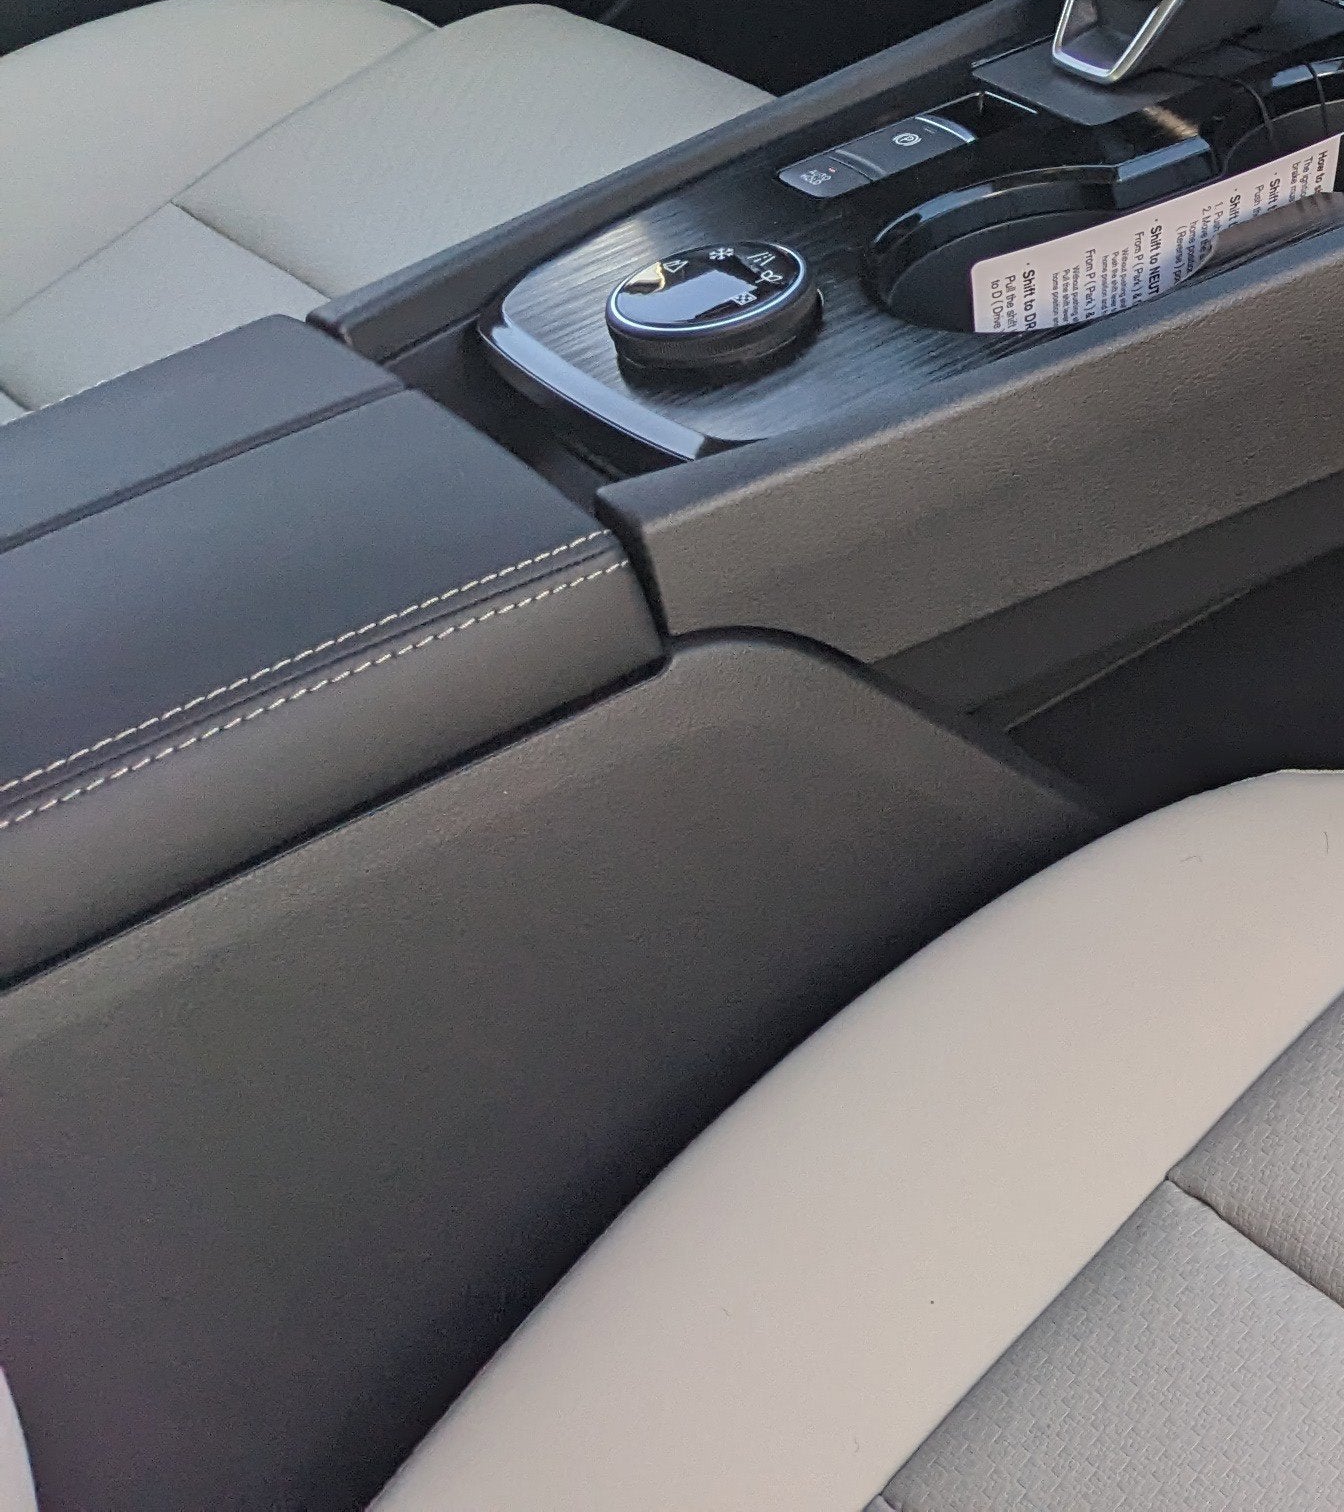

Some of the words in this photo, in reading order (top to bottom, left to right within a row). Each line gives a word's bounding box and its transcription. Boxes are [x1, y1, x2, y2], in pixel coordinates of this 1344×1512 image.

[1315, 172, 1325, 184] to
[1267, 178, 1281, 205] Shift
[1228, 194, 1241, 222] Shift
[1150, 225, 1162, 253] Shift
[1149, 252, 1160, 265] to
[990, 279, 1000, 290] to
[1022, 269, 1036, 299] Shift
[1023, 298, 1035, 312] to
